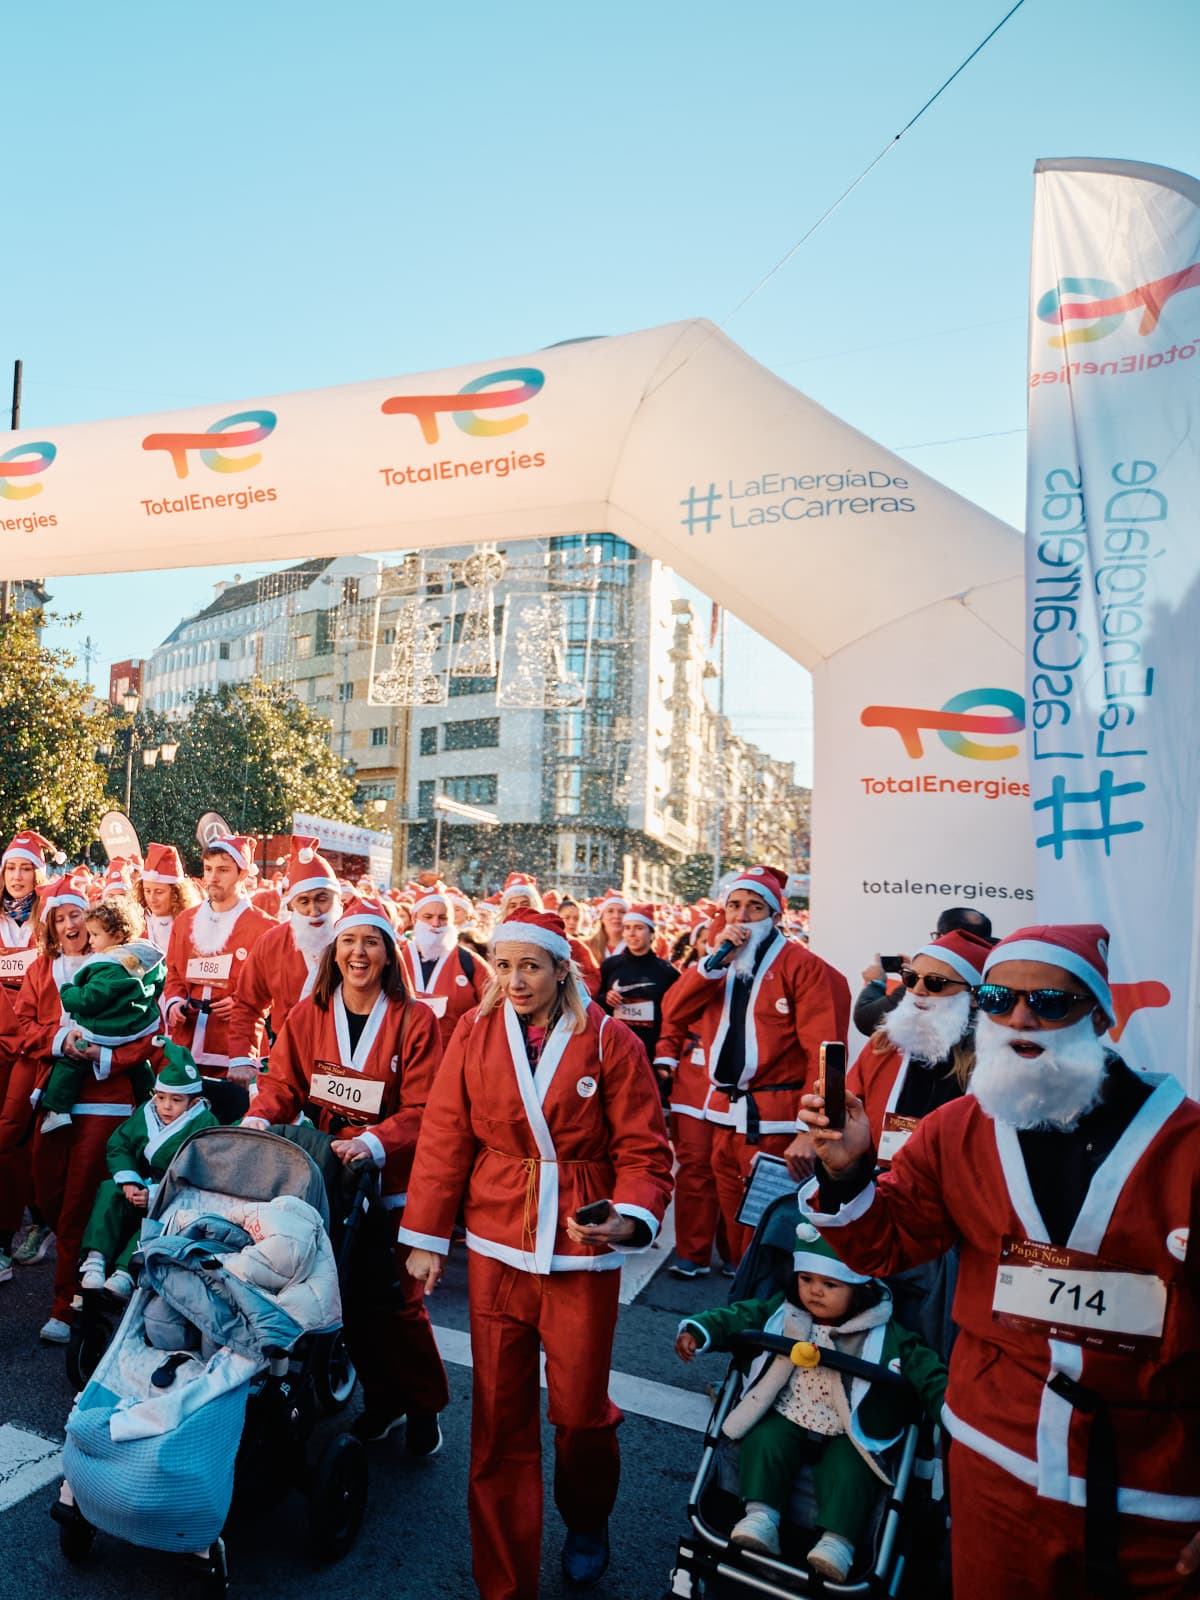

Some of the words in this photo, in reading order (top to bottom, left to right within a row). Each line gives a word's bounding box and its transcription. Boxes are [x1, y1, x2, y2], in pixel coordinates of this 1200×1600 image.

[380, 449, 546, 487] TotalEnergies
[141, 485, 277, 517] TotalEnergies
[729, 494, 916, 530] LasCarreras
[861, 776, 1031, 799] TotalEnergies
[862, 880, 1034, 901] totalenergies.es
[1, 960, 24, 970] 2076
[200, 961, 219, 974] 1888
[328, 1080, 361, 1103] 2010
[1010, 1243, 1038, 1258] Papá
[1041, 1250, 1070, 1267] Noel
[1048, 1278, 1106, 1316] 714
